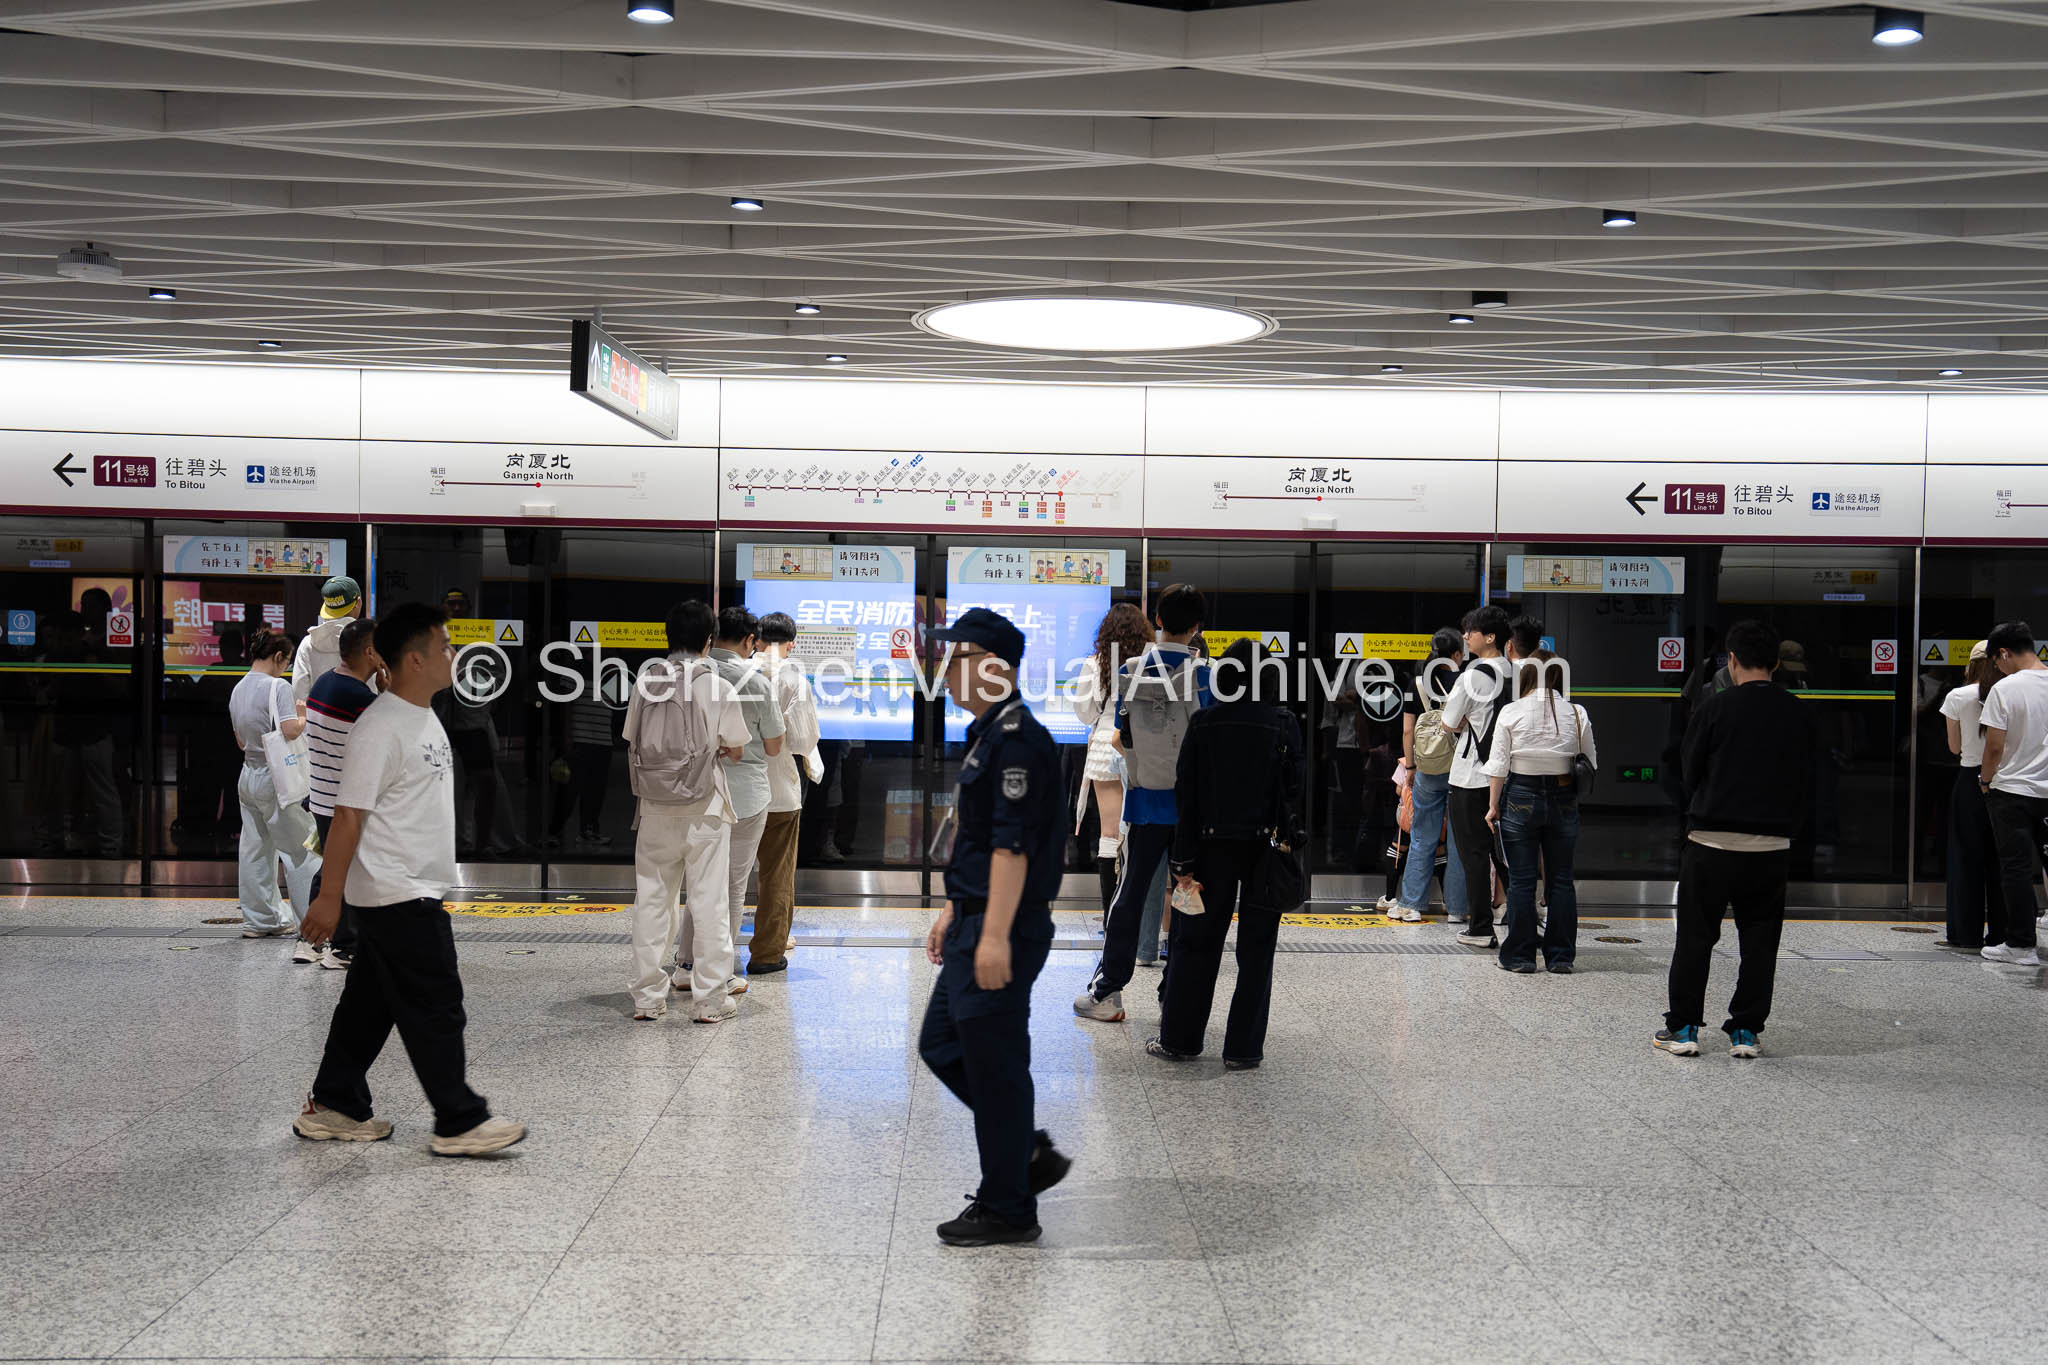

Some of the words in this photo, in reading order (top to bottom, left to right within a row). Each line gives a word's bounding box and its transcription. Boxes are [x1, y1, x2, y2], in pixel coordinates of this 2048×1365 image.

[166, 457, 227, 477] 往碧头
[506, 453, 571, 469] 岗厦北
[270, 465, 316, 478] 途经机场
[504, 471, 544, 482] Gangxia
[546, 472, 574, 480] North
[1288, 467, 1352, 483] 岗厦北
[165, 480, 176, 488] To
[180, 480, 205, 489] Bitou
[1284, 484, 1325, 495] Gangxia
[1328, 485, 1354, 494] North
[1734, 484, 1794, 504] 往碧头
[1834, 492, 1881, 504] 途经机场
[1733, 507, 1744, 516] To
[1747, 507, 1772, 516] Bitou
[839, 566, 880, 578] 车门关闭
[984, 568, 1025, 579] 有序上车
[1609, 578, 1650, 588] 车门关闭
[796, 600, 916, 626] 全民消防
